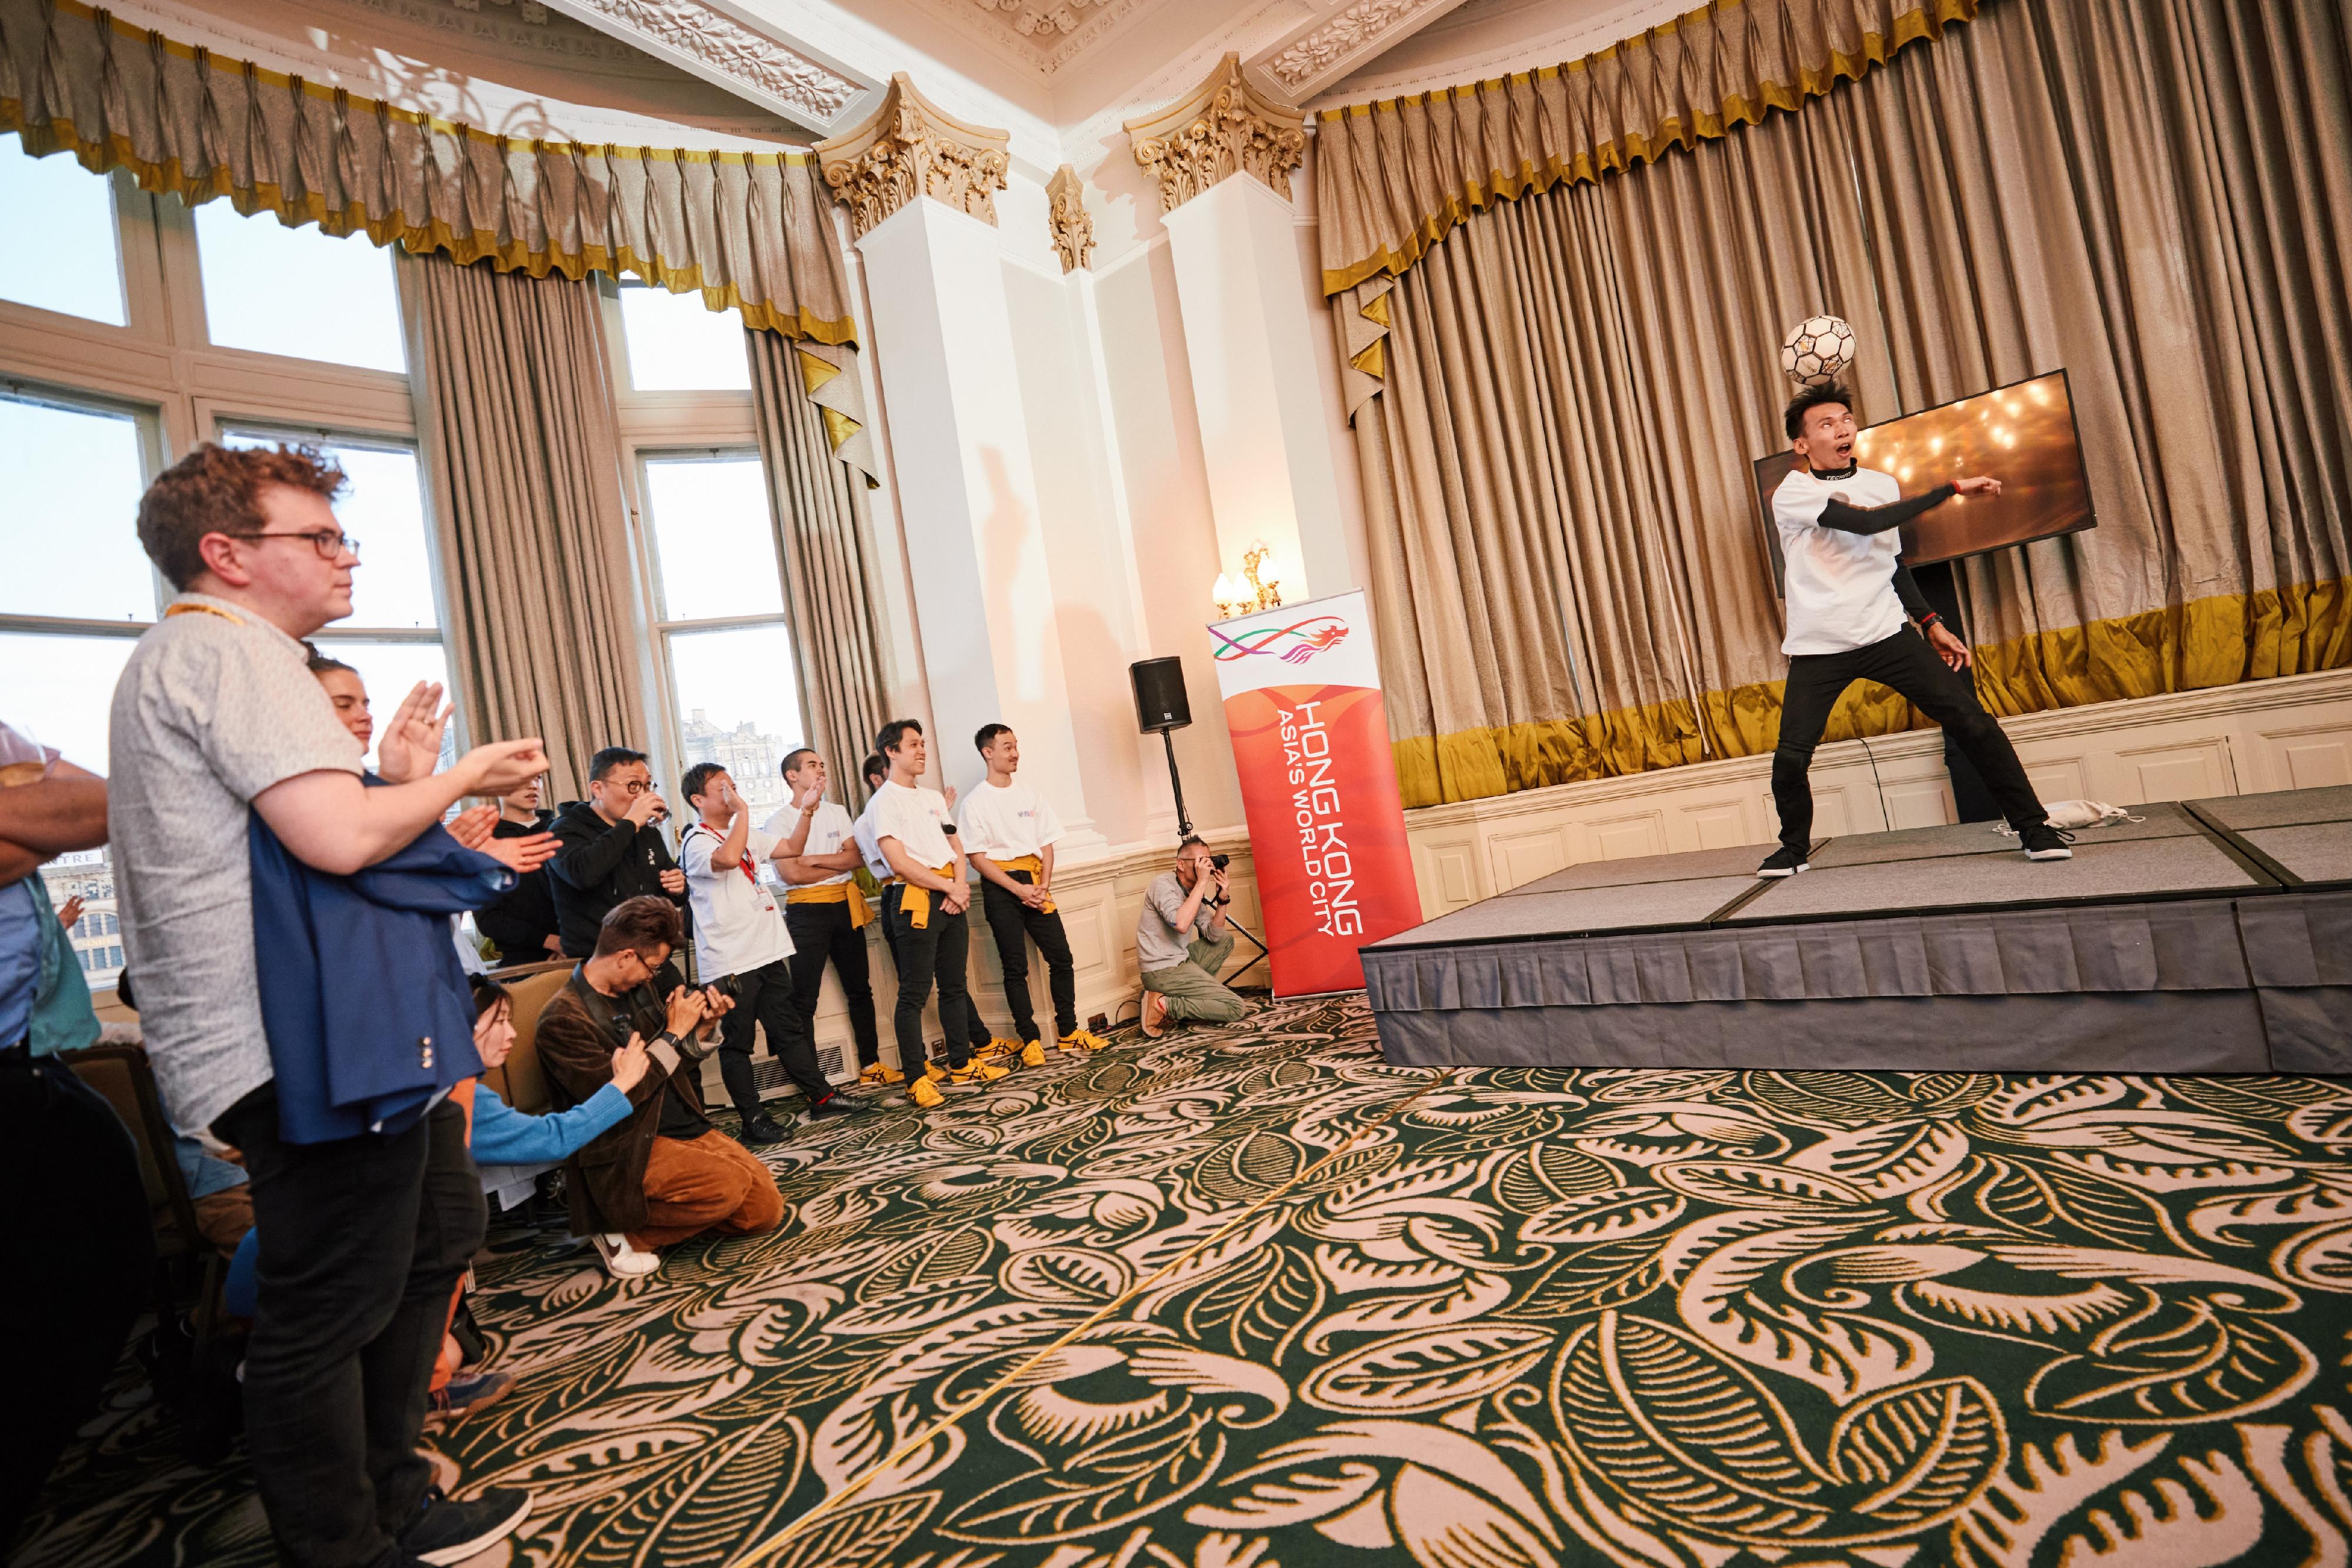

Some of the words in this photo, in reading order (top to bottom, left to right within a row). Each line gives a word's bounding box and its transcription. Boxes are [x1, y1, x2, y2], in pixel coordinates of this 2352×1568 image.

[1277, 709, 1305, 785] ASIA'S
[1292, 789, 1322, 876] WORLD
[1309, 881, 1335, 937] CITY
[1295, 701, 1341, 815] HONG
[1318, 822, 1364, 935] KONG
